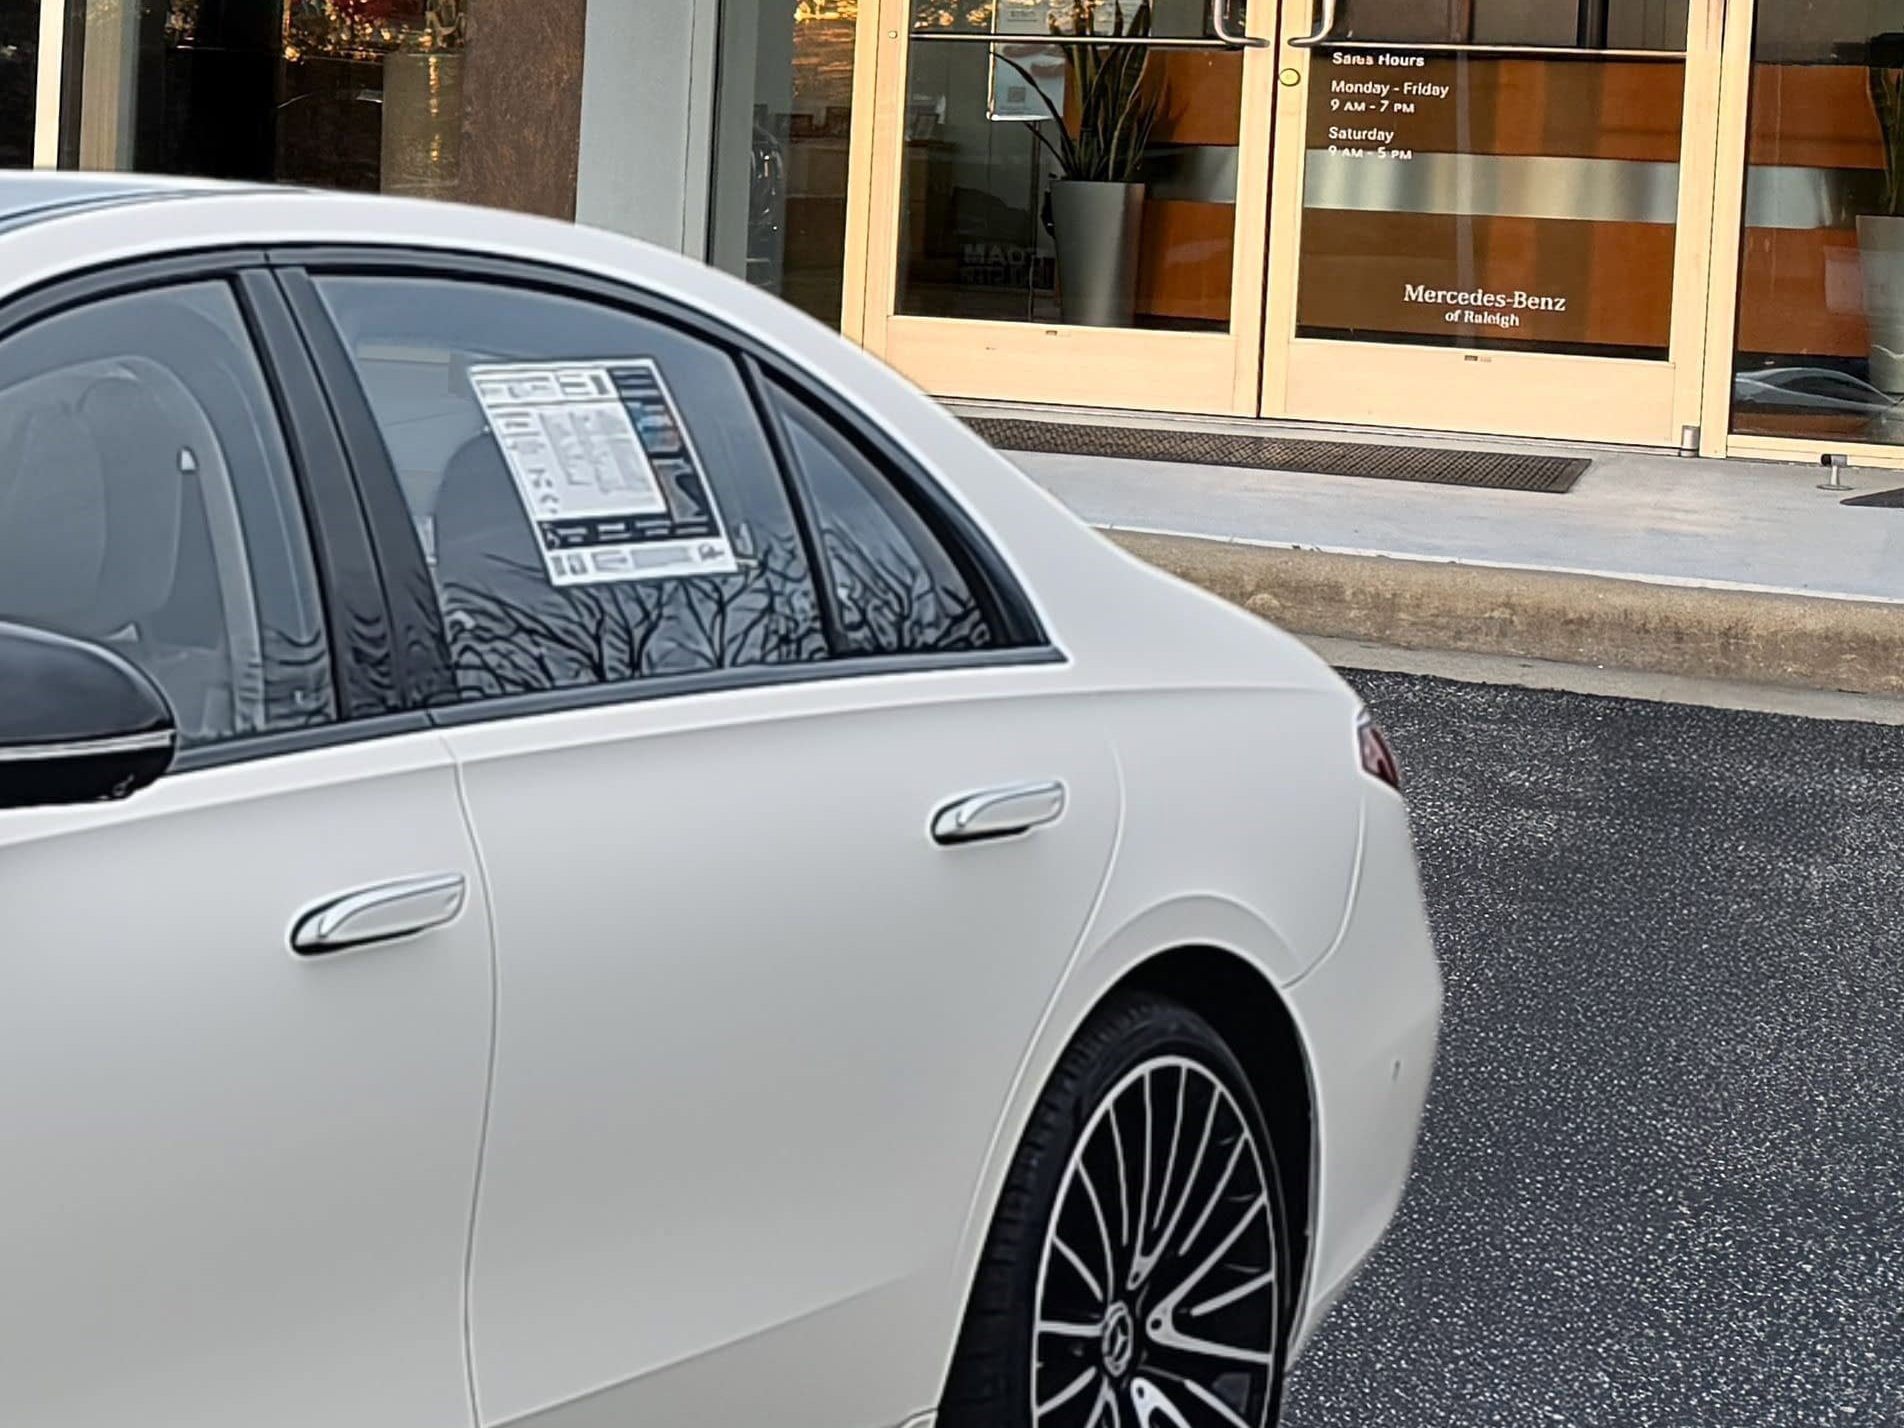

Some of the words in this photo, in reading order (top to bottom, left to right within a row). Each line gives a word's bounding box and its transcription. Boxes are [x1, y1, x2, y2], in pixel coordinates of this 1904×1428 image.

[1378, 53, 1425, 67] Hours
[1331, 80, 1390, 97] Monday
[1403, 82, 1449, 98] Friday
[1330, 99, 1340, 111] 9
[1344, 102, 1366, 112] AM
[1380, 100, 1389, 112] 7
[1394, 103, 1415, 113] PM
[1328, 127, 1394, 144] Saturday
[1328, 145, 1337, 157] 9
[1342, 148, 1363, 158] AM
[1377, 147, 1387, 159] 5
[1392, 150, 1412, 160] PM
[1404, 284, 1566, 312] Mercedes-Benz
[1445, 310, 1462, 322] of
[1464, 310, 1520, 329] Raleigh
